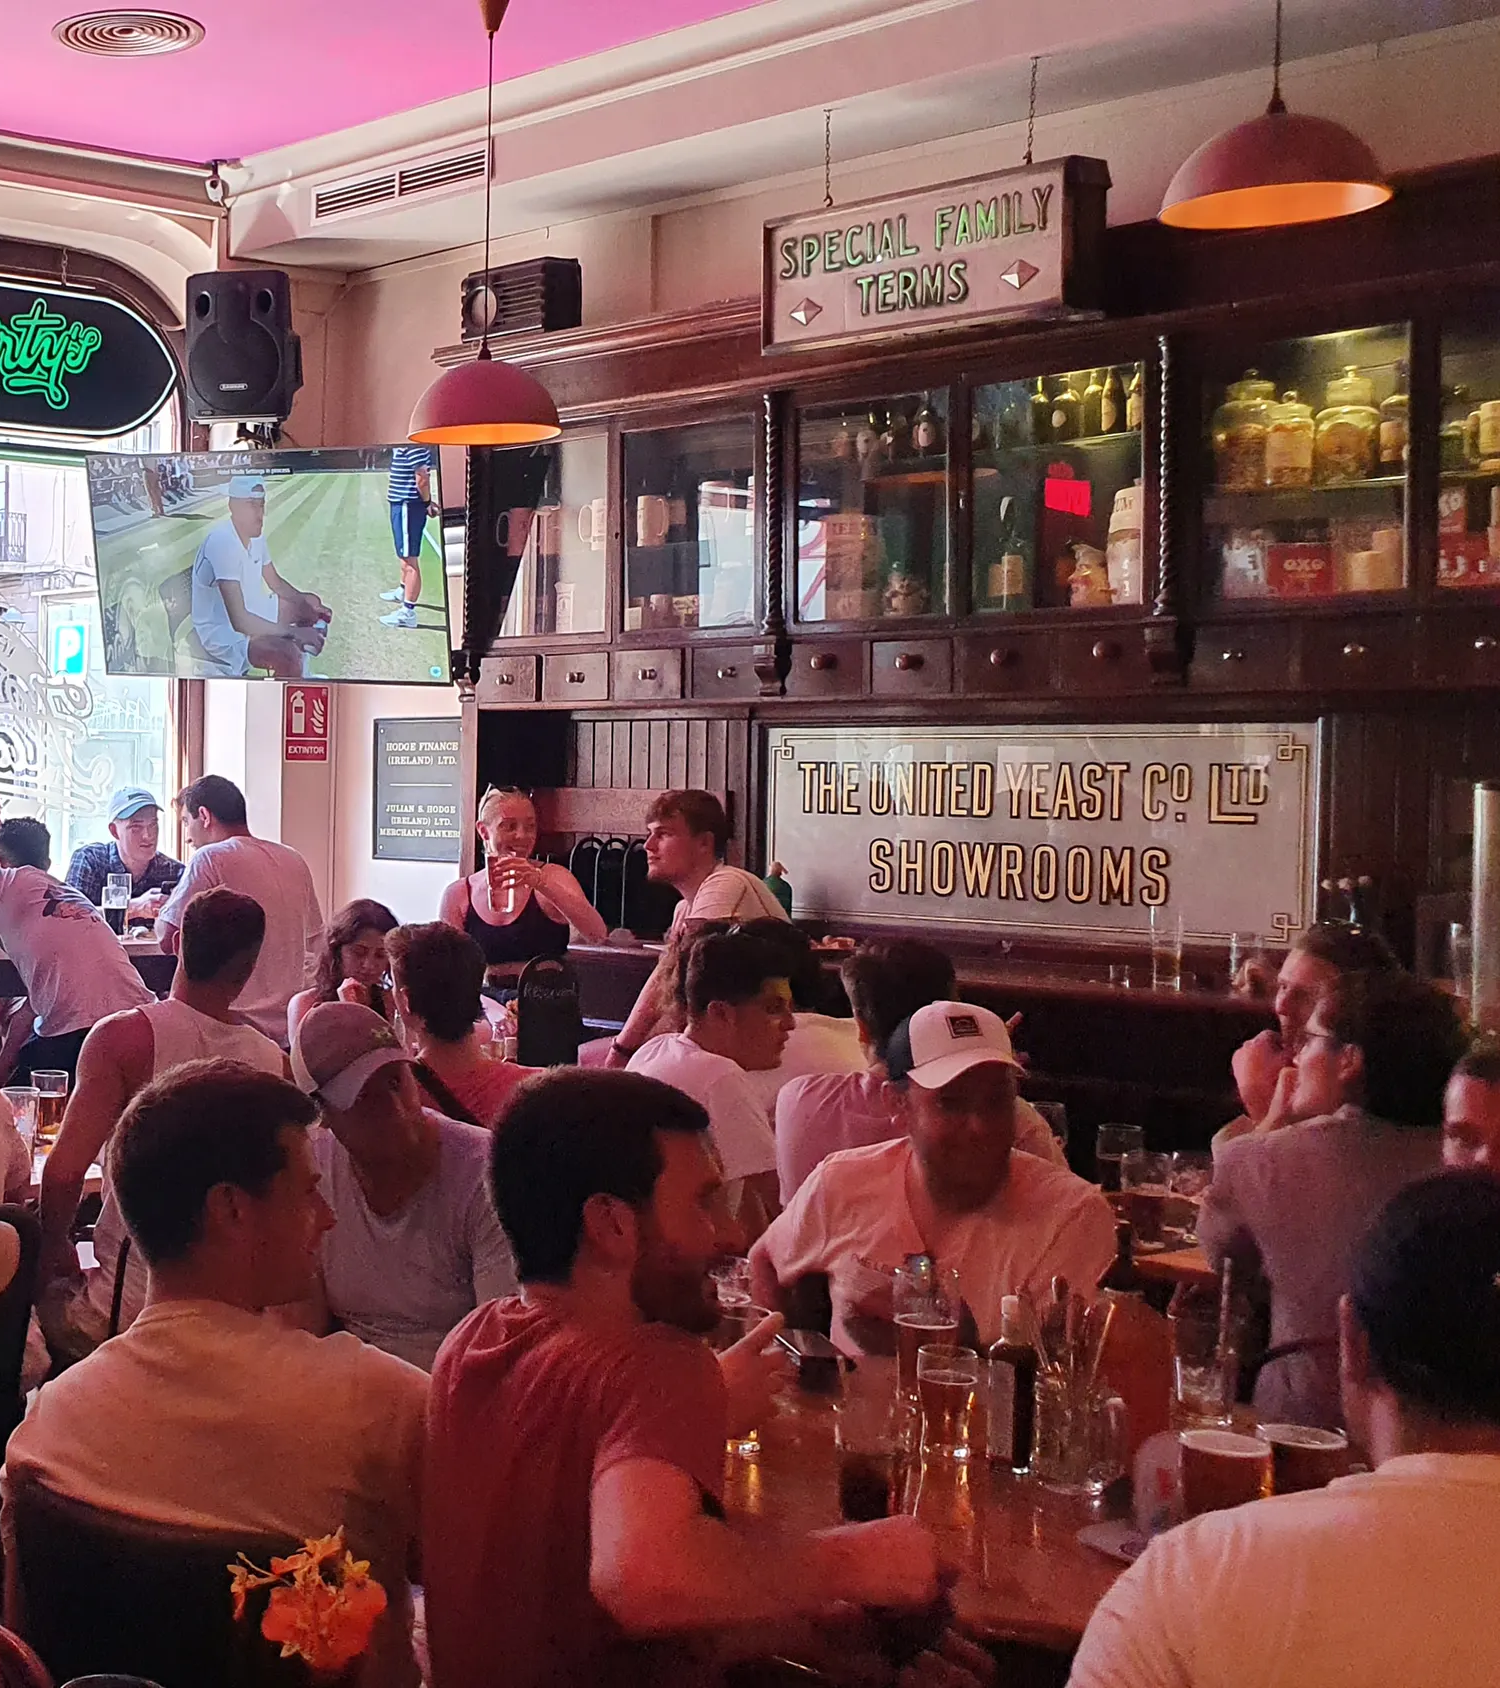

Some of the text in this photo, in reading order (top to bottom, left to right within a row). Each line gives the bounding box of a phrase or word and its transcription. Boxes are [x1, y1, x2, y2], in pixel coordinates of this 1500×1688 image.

[779, 183, 1054, 280] SPECIAL FAMILY
[855, 260, 969, 318] TERMS
[57, 627, 80, 672] P
[288, 745, 325, 754] EXTINTOR
[386, 742, 459, 752] HODGE FINANCE
[387, 755, 457, 766] (IRELAND) LTD.
[799, 762, 861, 815] THE
[868, 762, 993, 819] UNITED
[1002, 762, 1130, 822] YEAST
[386, 804, 415, 813] JULIAN
[426, 805, 456, 814] HODGE
[391, 816, 452, 826] (IRELAND) LTD.
[379, 828, 422, 837] MERCHANT
[868, 838, 1170, 907] SHOWROOMS
